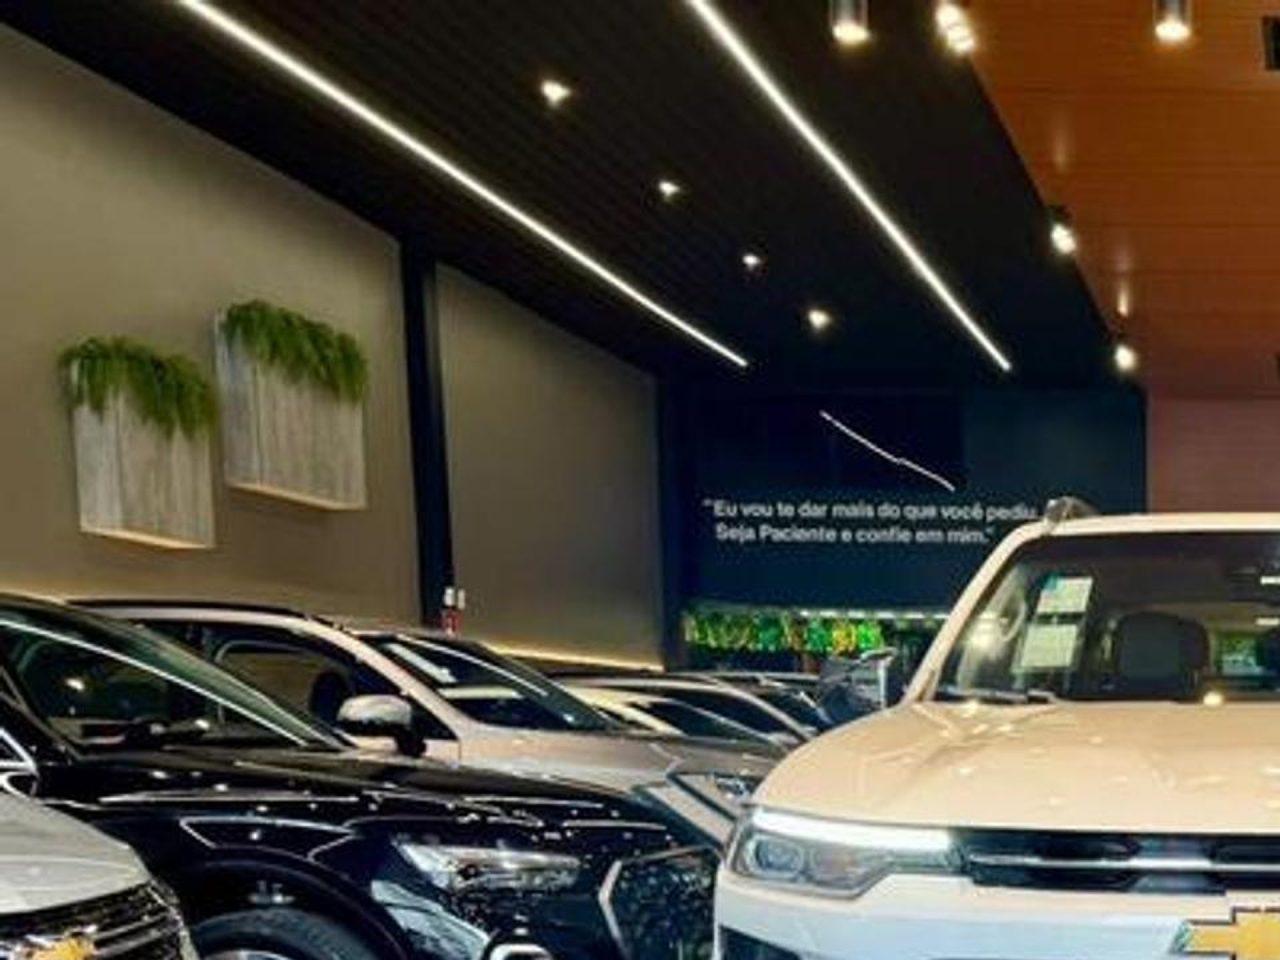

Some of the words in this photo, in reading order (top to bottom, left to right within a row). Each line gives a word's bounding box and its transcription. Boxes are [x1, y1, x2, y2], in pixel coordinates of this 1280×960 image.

[741, 503, 773, 517] vou
[777, 502, 795, 517] te
[798, 501, 827, 517] dar
[832, 501, 874, 517] mais
[877, 503, 899, 519] do
[903, 505, 936, 521] que
[941, 503, 983, 519] você
[715, 522, 756, 543] Seja
[759, 524, 837, 542] Paciente
[841, 529, 852, 541] e
[855, 526, 912, 542] confie
[915, 529, 943, 542] em
